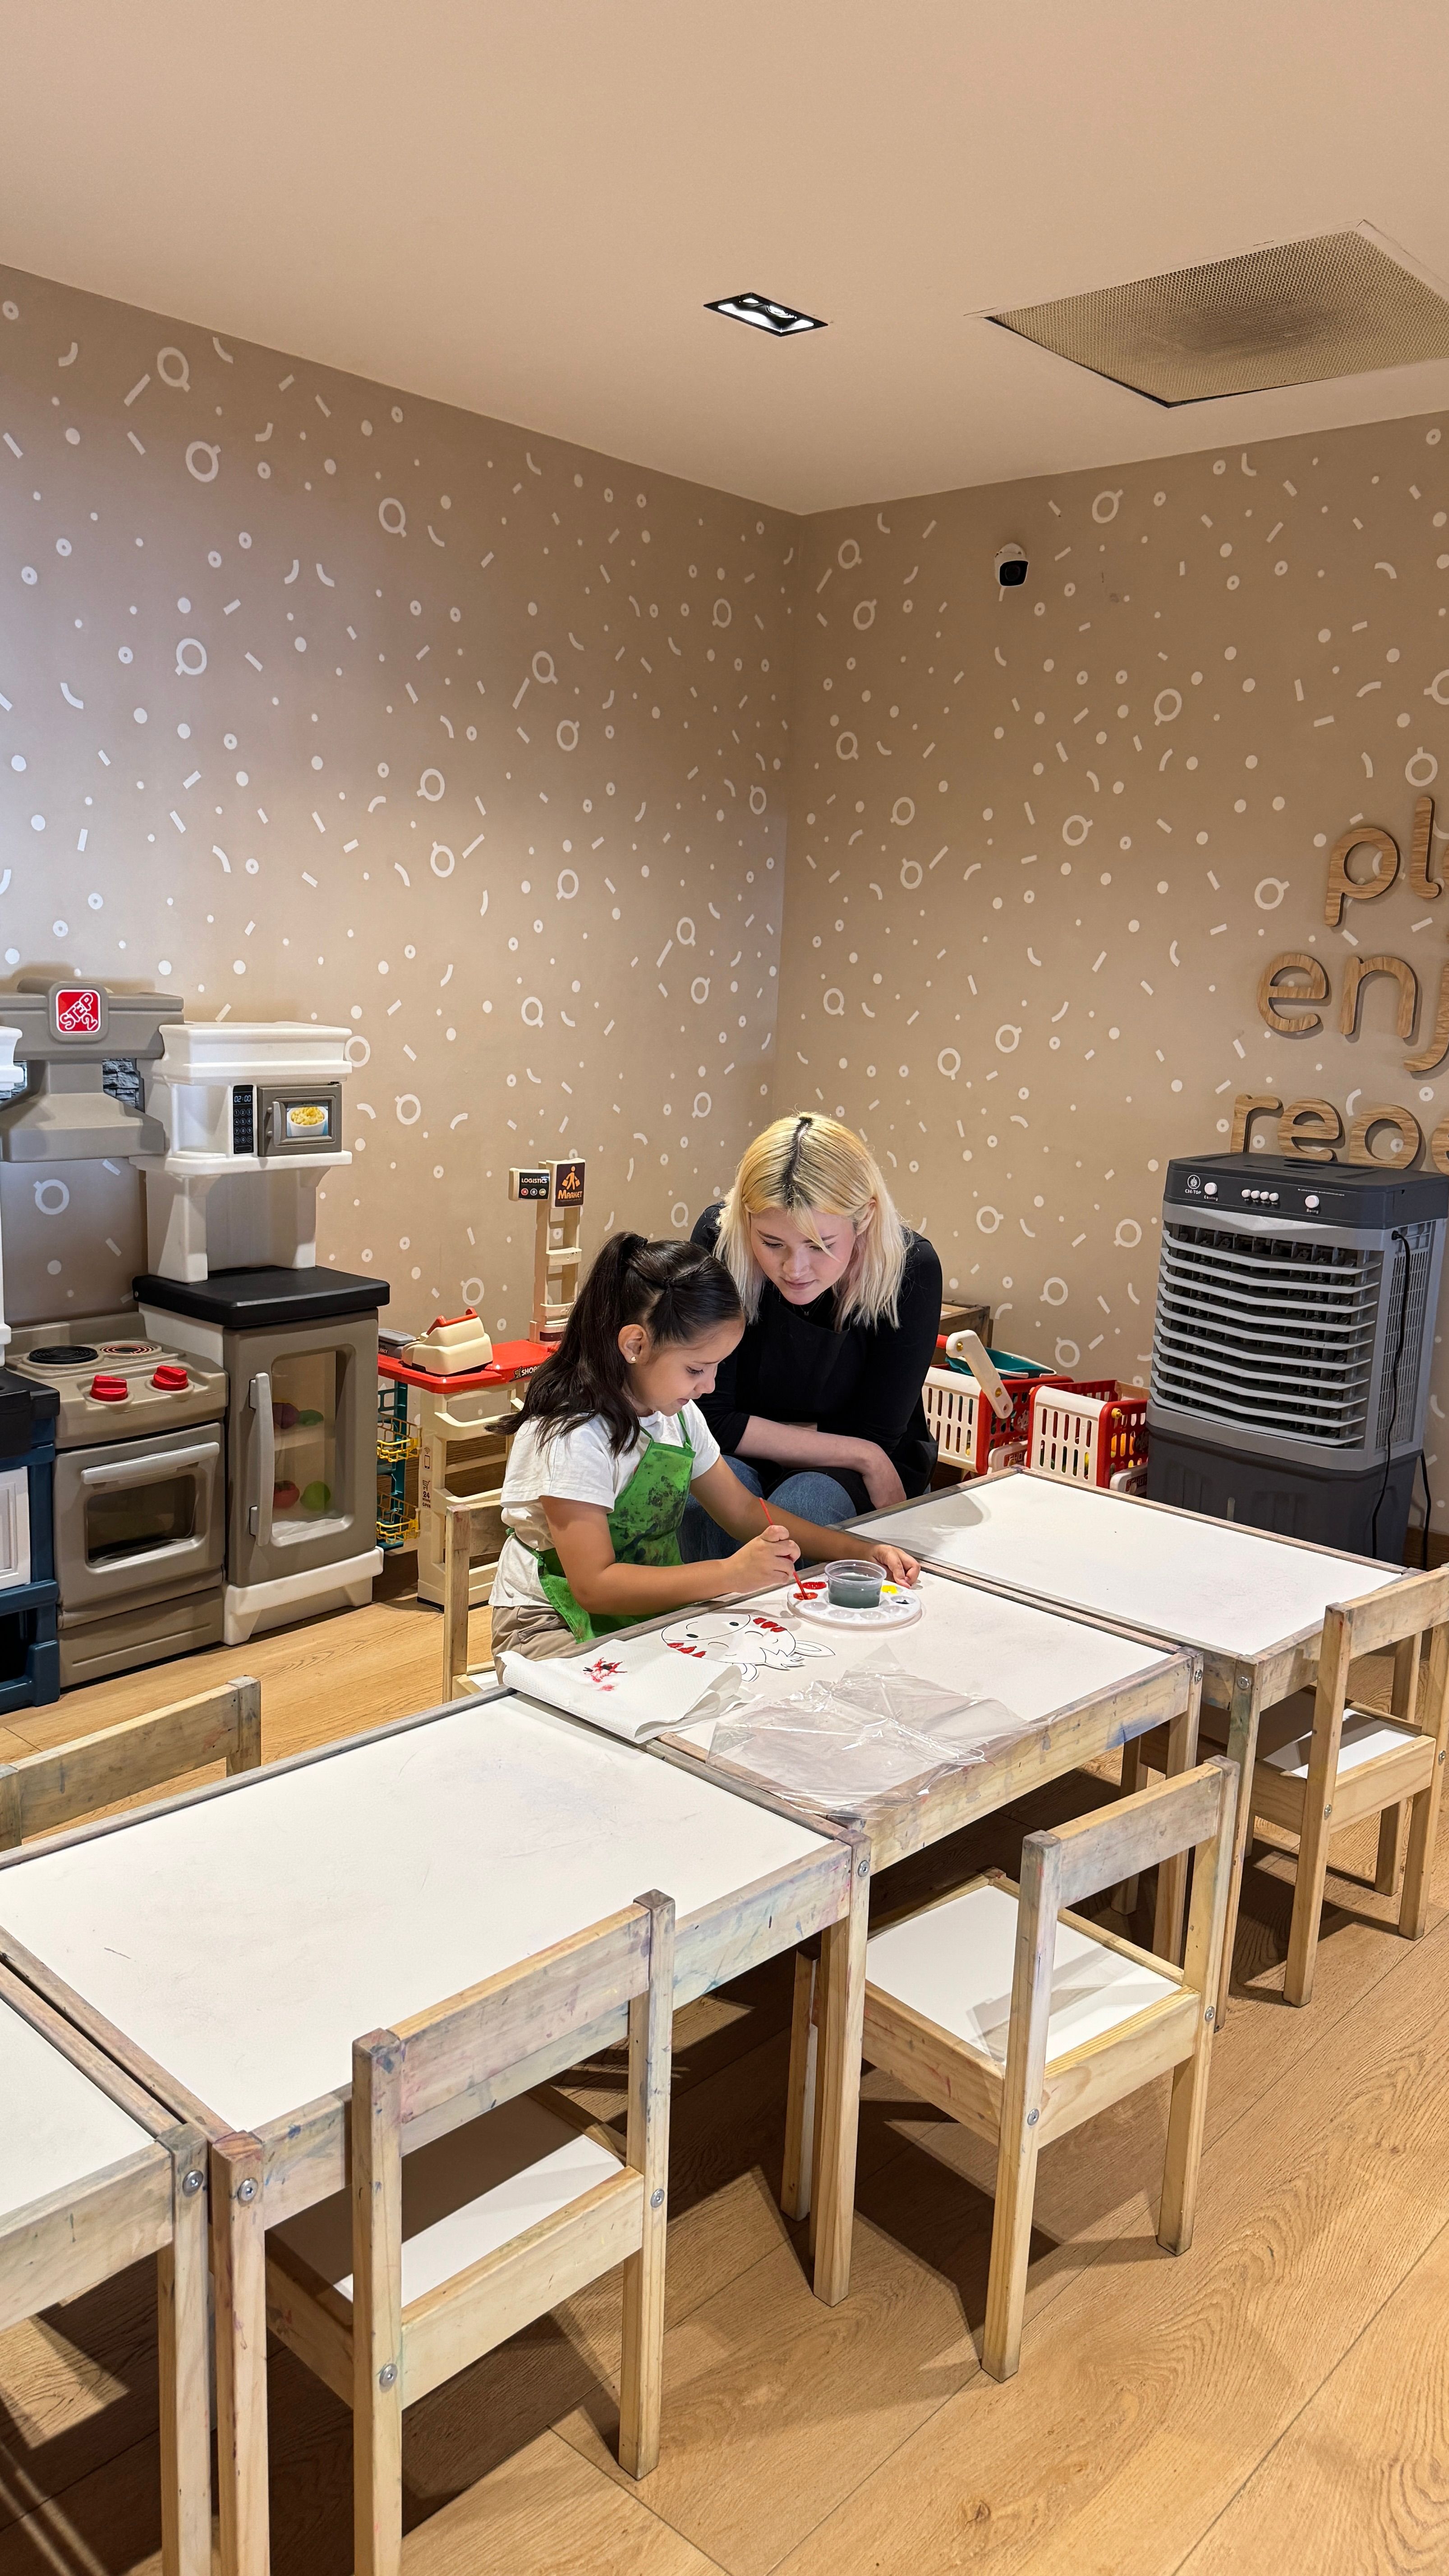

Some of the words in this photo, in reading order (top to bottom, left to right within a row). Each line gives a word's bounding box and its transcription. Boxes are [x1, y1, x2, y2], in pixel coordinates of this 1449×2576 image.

[1325, 796, 1449, 927] pl
[60, 993, 93, 1030] STEP
[82, 1013, 98, 1030] 2
[234, 1095, 251, 1103] 02:00
